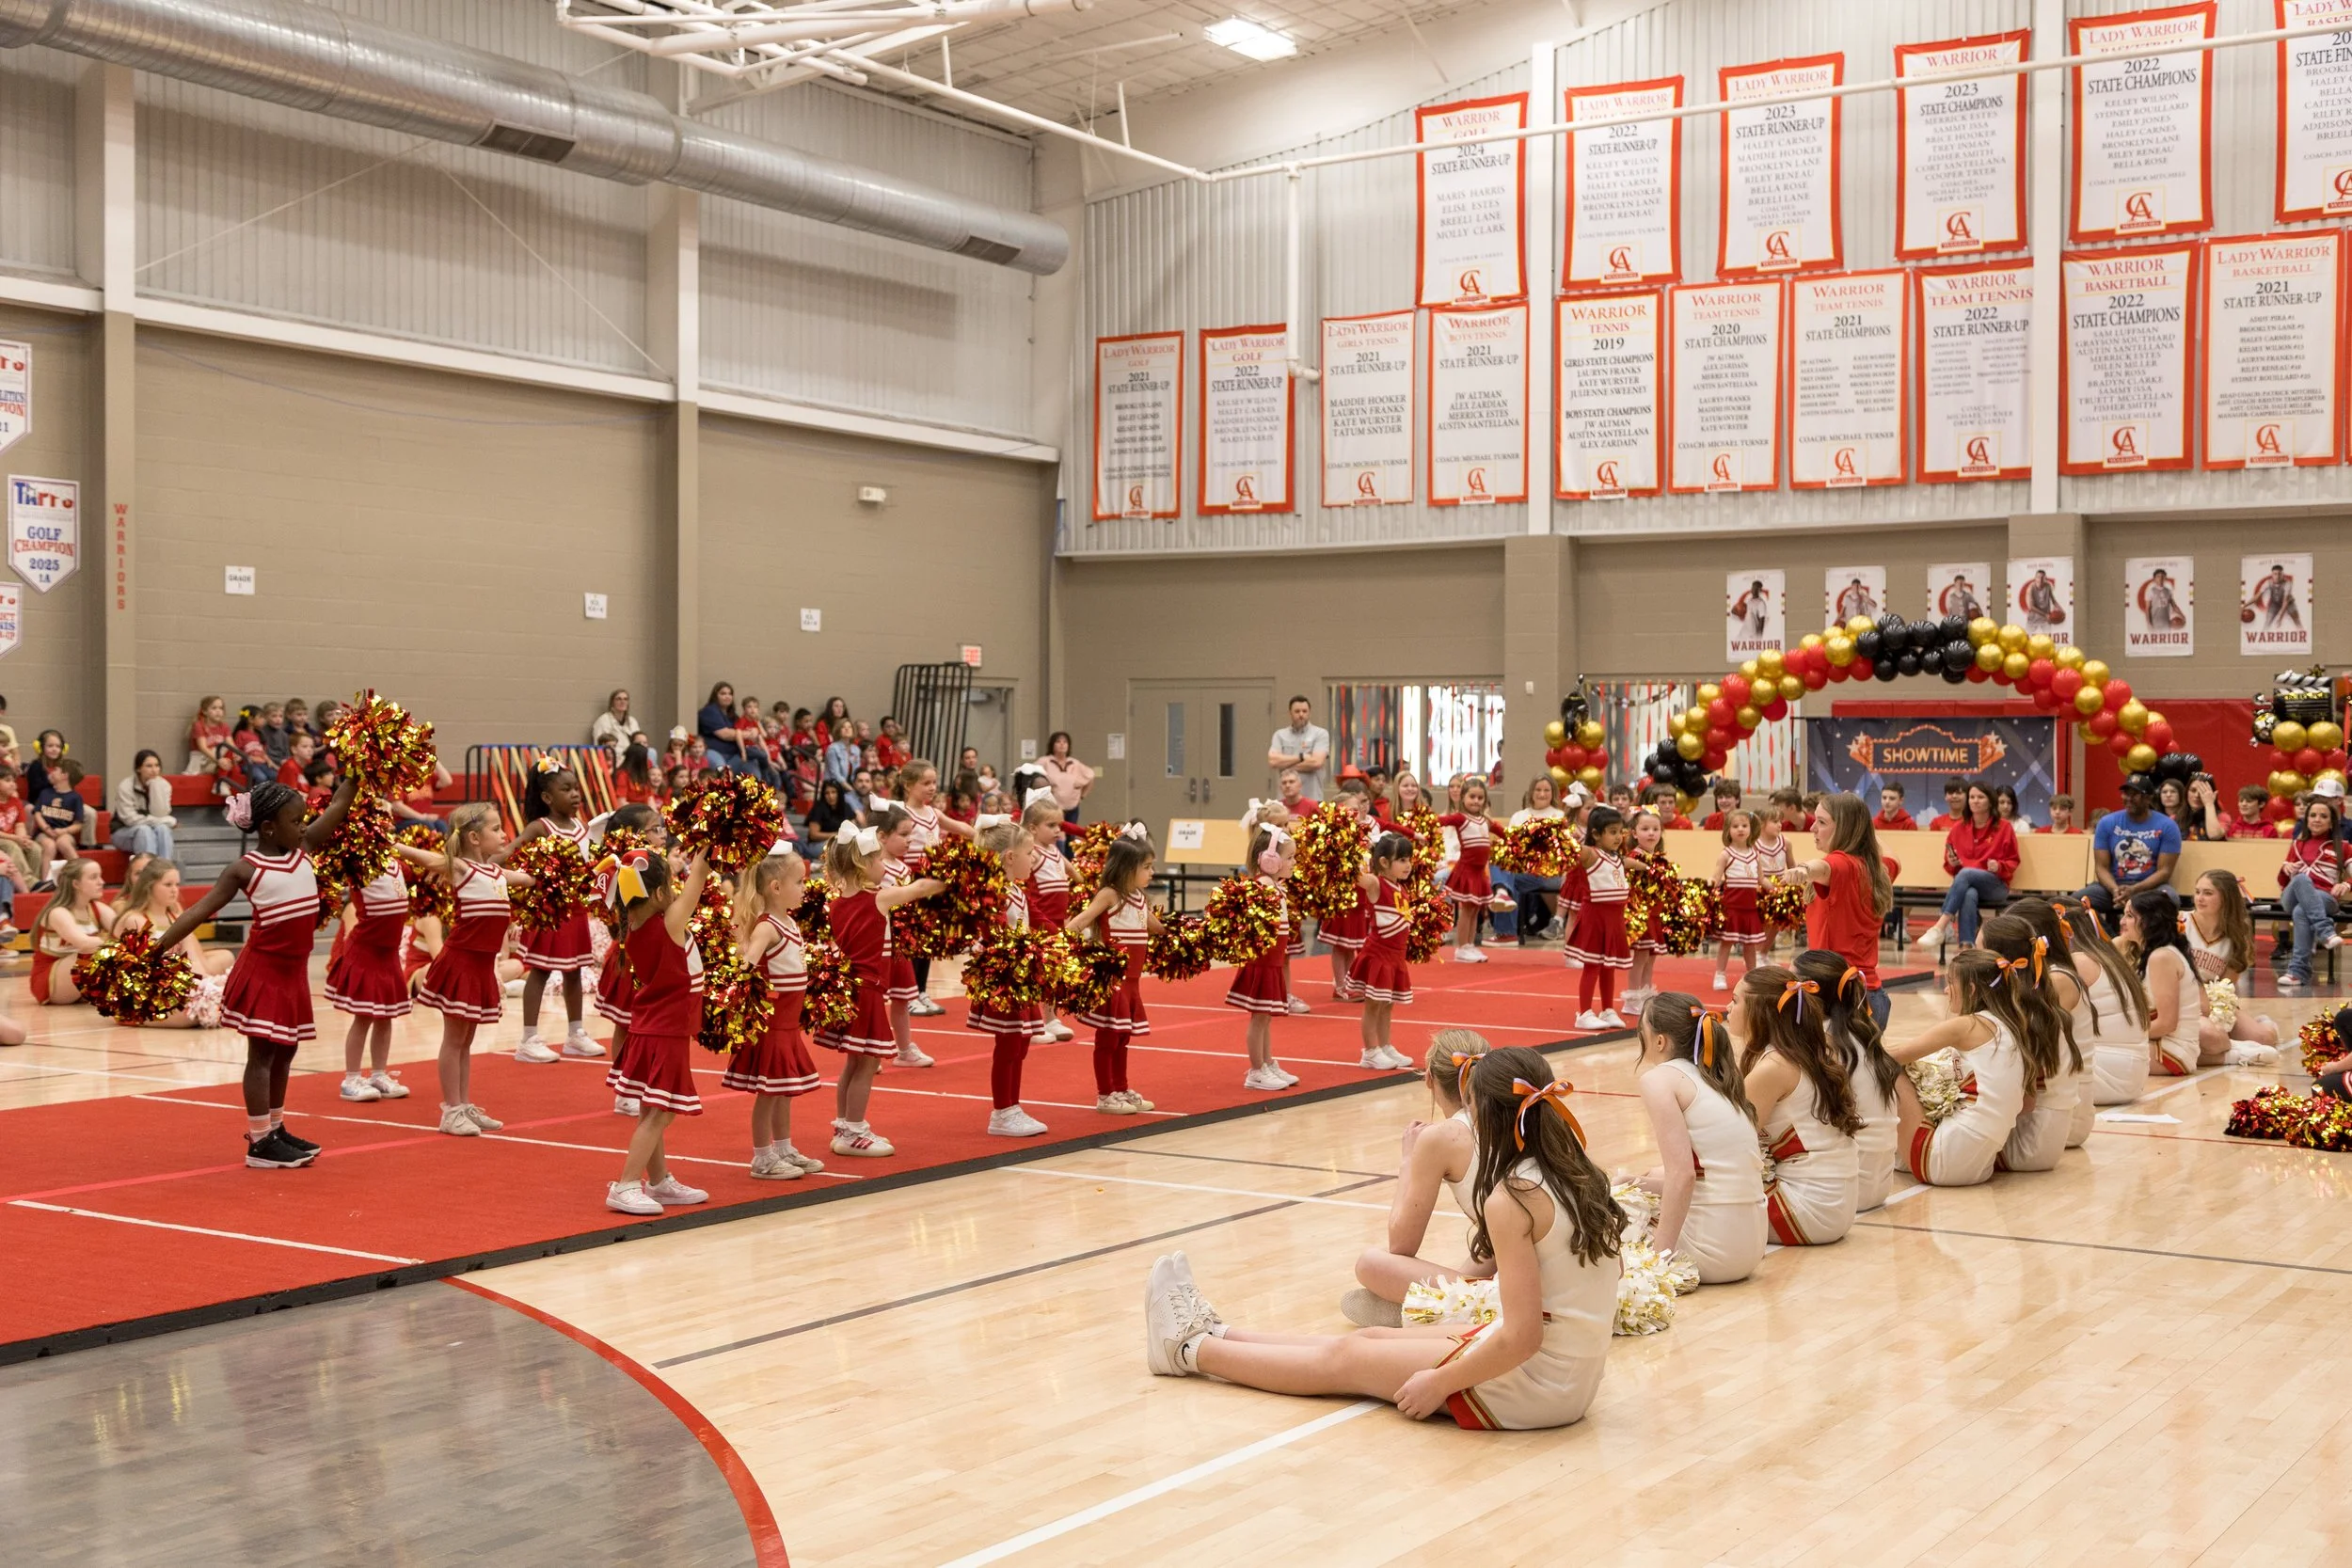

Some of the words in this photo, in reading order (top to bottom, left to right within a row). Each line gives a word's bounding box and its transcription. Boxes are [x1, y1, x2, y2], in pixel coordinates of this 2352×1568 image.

[2296, 2, 2333, 15] LADY
[2090, 29, 2125, 44] LADY
[2132, 20, 2198, 39] WARRIOR
[1927, 49, 1996, 68] WARRIOR
[2296, 49, 2333, 67] STATE
[2124, 58, 2160, 73] 2022
[1736, 78, 1766, 91] LADY
[1771, 71, 1827, 85] WARRIOR
[2089, 77, 2122, 94] STATE
[2125, 68, 2197, 91] CHAMPIONS
[1945, 83, 1979, 98] 2023
[1581, 100, 1608, 111] LADY
[1614, 93, 1667, 106] WARRIOR
[1920, 103, 1947, 116] STATE
[1948, 95, 2003, 113] CHAMPIONS
[1442, 111, 1500, 128] WARRIOR
[1765, 105, 1796, 120] 2023
[1736, 124, 1766, 138] STATE
[1769, 117, 1825, 135] RUNNER-UP
[2112, 119, 2139, 128] EMILY
[2142, 115, 2170, 123] JONES
[1609, 125, 1637, 138] 2022
[2156, 135, 2180, 144] LANE
[1457, 144, 1485, 158] 2024
[1588, 142, 1611, 155] STATE
[1432, 160, 1458, 175] STATE
[1459, 154, 1511, 170] RUNNER-UP
[2113, 159, 2141, 168] BELLA
[2145, 157, 2168, 166] ROSE
[1437, 228, 1468, 240] MOLLY
[1473, 224, 1505, 235] CLARK
[2217, 251, 2257, 264] LADY
[2260, 245, 2330, 261] WARRIOR
[2089, 259, 2164, 276] WARRIOR
[2233, 263, 2312, 277] BASKETBALL
[1947, 274, 2016, 290] WARRIOR
[2085, 276, 2170, 293] BASKETBALL
[2256, 281, 2289, 294] 2021
[1813, 284, 1885, 298] WARRIOR
[1930, 294, 1973, 307] TEAM
[1979, 288, 2033, 302] TENNIS
[1692, 293, 1761, 307] WARRIOR
[1815, 303, 1843, 312] TEAM
[1846, 299, 1883, 309] TENNIS
[2108, 293, 2144, 309] 2022
[2223, 296, 2256, 309] STATE
[2258, 292, 2322, 307] RUNNER-UP
[1570, 304, 1646, 321] WARRIOR
[1693, 311, 1722, 320] TEAM
[1723, 308, 1760, 318] TENNIS
[1964, 307, 1998, 321] 2022
[2073, 312, 2107, 329] STATE
[2109, 307, 2181, 326] CHAMPIONS
[1449, 316, 1510, 329] WARRIOR
[1835, 314, 1862, 327] 2021
[1328, 325, 1355, 337] LADY
[1359, 323, 1407, 334] WARRIOR
[1589, 322, 1629, 334] TENNIS
[1712, 323, 1740, 336] 2020
[1805, 328, 1834, 341] STATE
[1836, 325, 1891, 340] CHAMPIONS
[1933, 324, 1965, 338] STATE
[1967, 319, 2029, 335] RUNNER-UP
[1366, 338, 1399, 346] TENNIS
[1450, 334, 1472, 342] BOYS
[1475, 330, 1507, 340] TENNIS
[1685, 337, 1711, 350] STATE
[1713, 334, 1768, 347] CHAMPIONS
[1212, 341, 1236, 351] LADY
[1240, 338, 1285, 347] WARRIOR
[1467, 345, 1491, 356] 2021
[1594, 337, 1625, 350] 2019
[2077, 347, 2111, 356] AUSTIN
[2114, 342, 2174, 353] SANTELLANA
[1104, 347, 1129, 358] LADY
[1131, 344, 1175, 355] WARRIOR
[1232, 352, 1263, 362] GOLF
[1356, 352, 1379, 362] 2021
[1439, 358, 1465, 370] STATE
[1468, 354, 1518, 367] RUNNER-UP
[1565, 358, 1583, 368] GIRLS
[1586, 356, 1607, 366] STATE
[1610, 353, 1654, 365] CHAMPIONS
[1234, 365, 1259, 377] 2022
[1330, 364, 1356, 376] STATE
[1358, 360, 1406, 373] RUNNER-UP
[1577, 368, 1608, 377] LAURYN
[1611, 366, 1642, 375] FRANKS
[1129, 372, 1150, 382] 2021
[1212, 380, 1235, 392] STATE
[1237, 376, 1282, 390] RUNNER-UP
[1579, 378, 1597, 388] KATE
[1599, 376, 1639, 386] WURSTER
[1108, 384, 1128, 394] STATE
[1131, 381, 1169, 392] RUNNER-UP
[1570, 388, 1608, 399] JULIENNE
[1611, 386, 1646, 395] SWEENEY
[1330, 398, 1365, 407] MADDIE
[1368, 395, 1406, 404] HOOKER
[1455, 392, 1466, 401] JW
[1468, 390, 1502, 400] ALTMAN
[1331, 407, 1367, 417] LAURYN
[1370, 404, 1405, 414] FRANKS
[1449, 411, 1484, 420] MERRICK
[1486, 409, 1509, 418] ESTES
[1566, 409, 1581, 419] BOYS
[1583, 407, 1605, 418] STATE
[1607, 404, 1651, 417] CHAMPIONS
[1333, 418, 1359, 427] KATE
[1359, 415, 1402, 425] WURSTER
[1438, 421, 1467, 430] AUSTIN
[1469, 419, 1519, 429] SANTELLANA
[1584, 420, 1596, 429] JW
[1598, 419, 1630, 428] ALTMAN
[1333, 428, 1365, 436] TATUM
[1367, 425, 1402, 435] SNYDER
[1568, 431, 1596, 439] AUSTIN
[1597, 427, 1649, 437] SANTELLANA
[1581, 440, 1598, 449] ALEX
[27, 527, 62, 541] GOLF
[14, 540, 75, 557] CHAMPION
[114, 503, 128, 610] WARRIORS
[29, 558, 60, 571] 2025
[2130, 632, 2188, 644] WARRIOR
[2246, 631, 2307, 643] WARRIOR
[1731, 640, 1781, 651] WARRIOR
[1883, 747, 1968, 764] SHOWTIME
